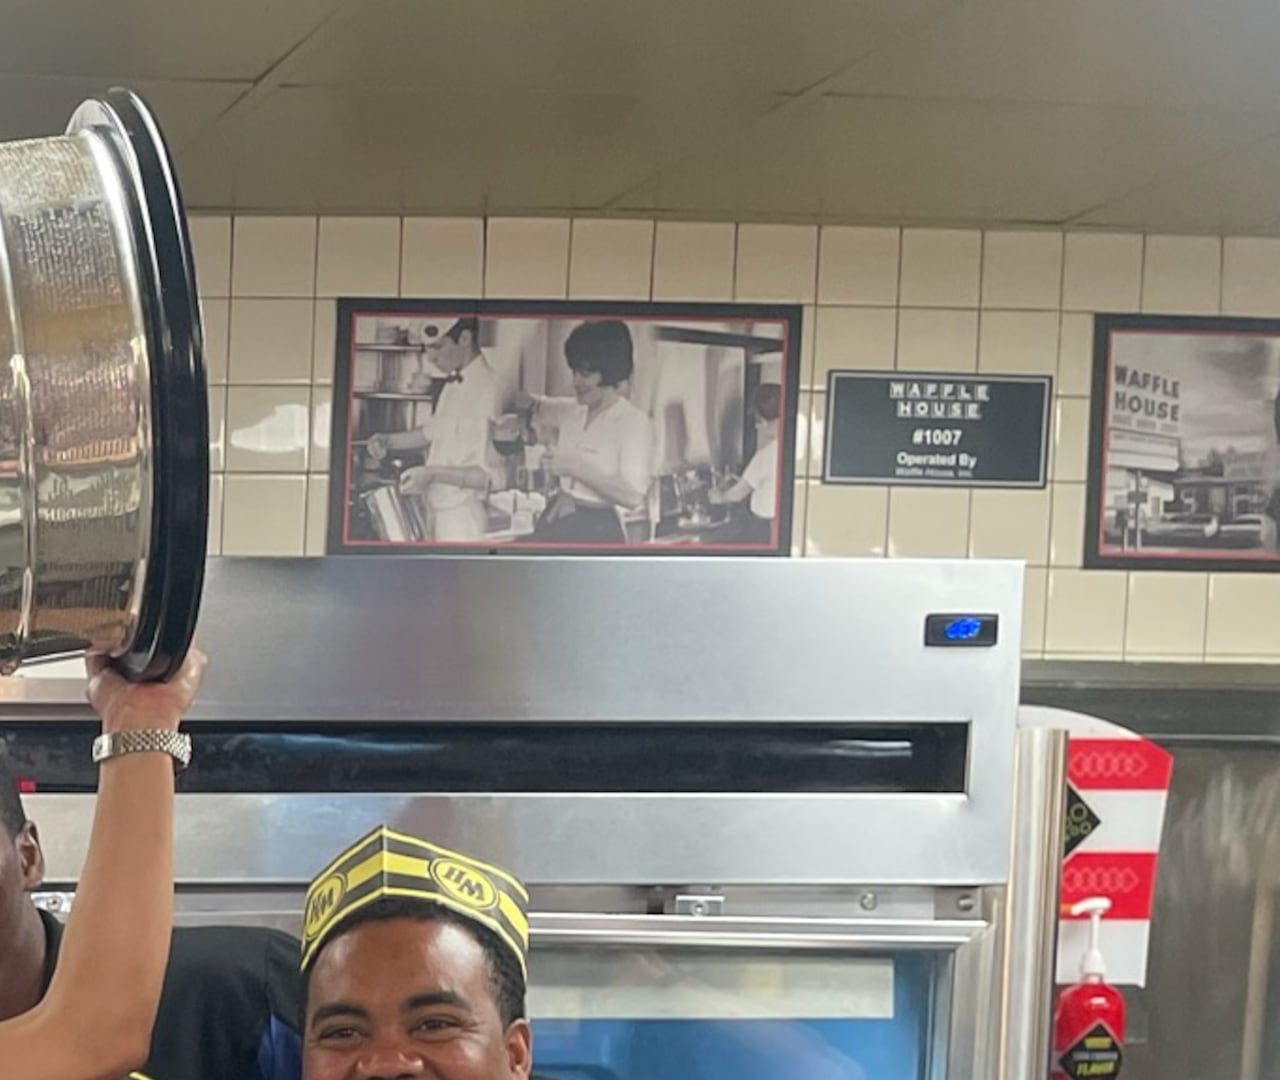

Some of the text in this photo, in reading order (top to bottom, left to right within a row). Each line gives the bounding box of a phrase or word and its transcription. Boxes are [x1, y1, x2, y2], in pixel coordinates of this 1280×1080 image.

[890, 381, 989, 401] WAFFLE
[1114, 365, 1180, 398] WAFFLE
[897, 401, 982, 419] HOUSE
[1114, 391, 1180, 422] HOUSE
[912, 429, 962, 445] #1007
[896, 452, 977, 469] Operated By
